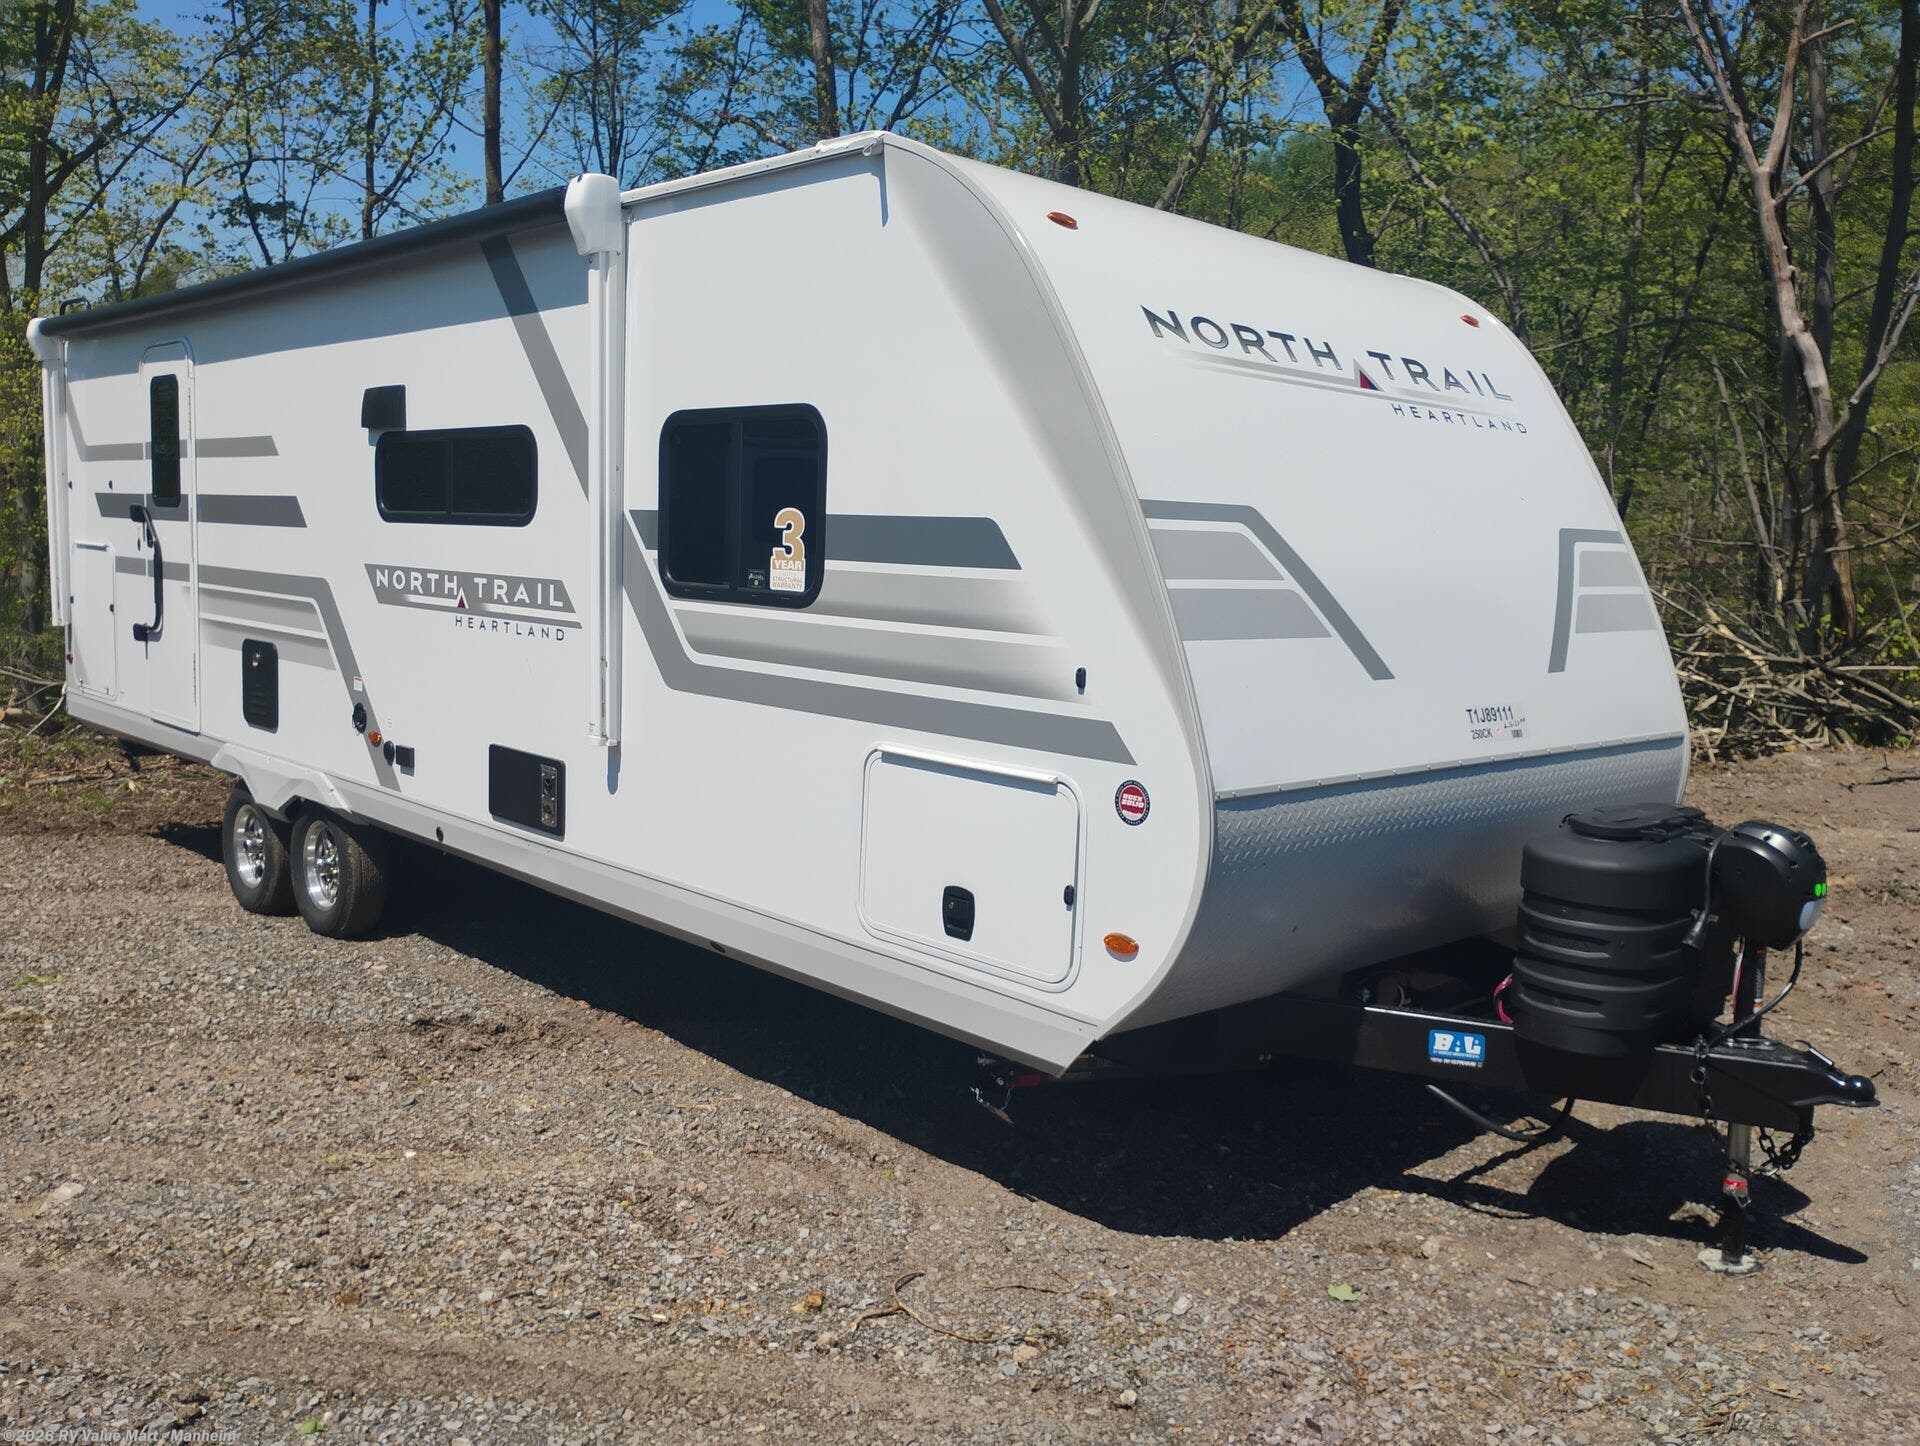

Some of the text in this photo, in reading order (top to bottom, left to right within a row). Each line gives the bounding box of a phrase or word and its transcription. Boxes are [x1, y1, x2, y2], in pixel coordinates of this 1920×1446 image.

[1140, 304, 1513, 402] NORTH TRAIL
[1391, 402, 1528, 434] HEARTLAND
[772, 507, 805, 560] 3
[774, 559, 802, 571] YEAR
[376, 568, 564, 608] NORTH TRAIL
[455, 615, 566, 641] HEARTLAND
[1465, 705, 1514, 724] T1J89111
